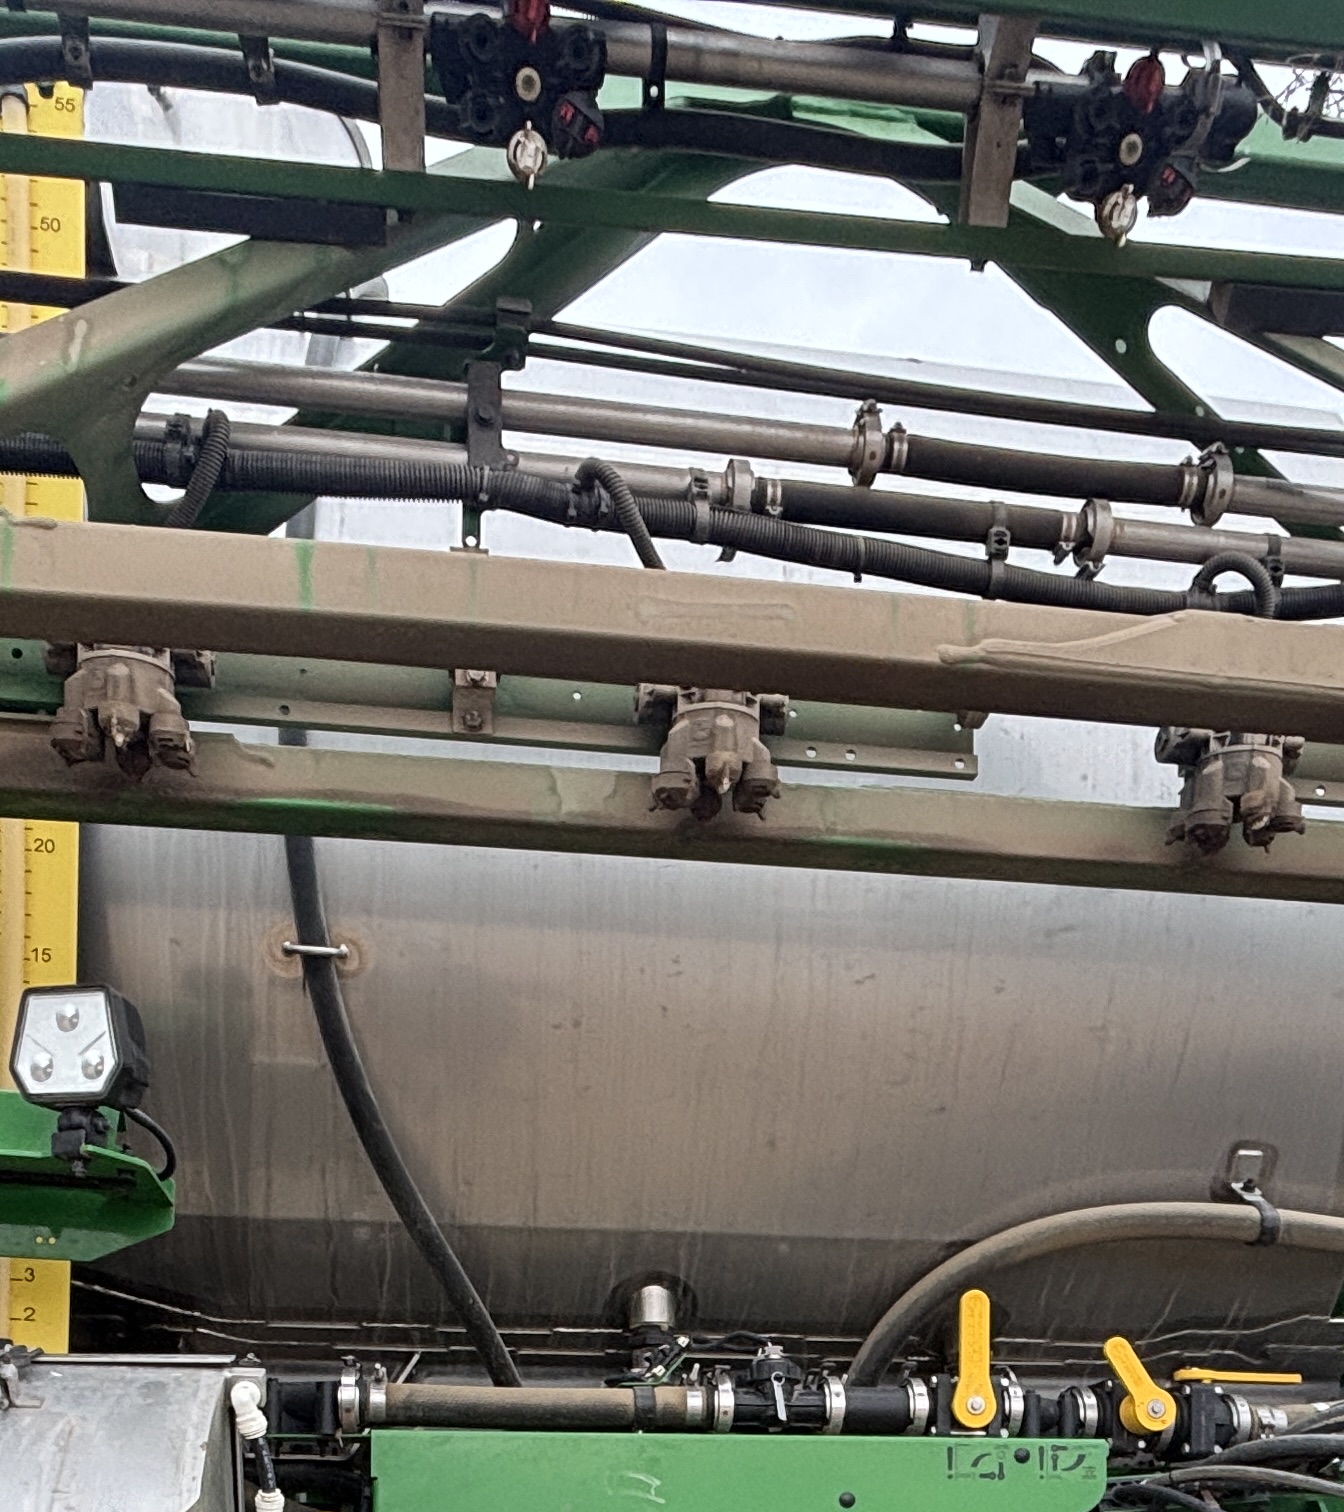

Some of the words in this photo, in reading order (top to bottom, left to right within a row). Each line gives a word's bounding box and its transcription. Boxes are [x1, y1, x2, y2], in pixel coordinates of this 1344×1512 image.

[55, 97, 76, 113] 55
[40, 217, 62, 233] 50
[34, 838, 55, 853] 20
[31, 948, 52, 962] 15
[24, 1268, 36, 1282] 3
[23, 1307, 36, 1321] 2
